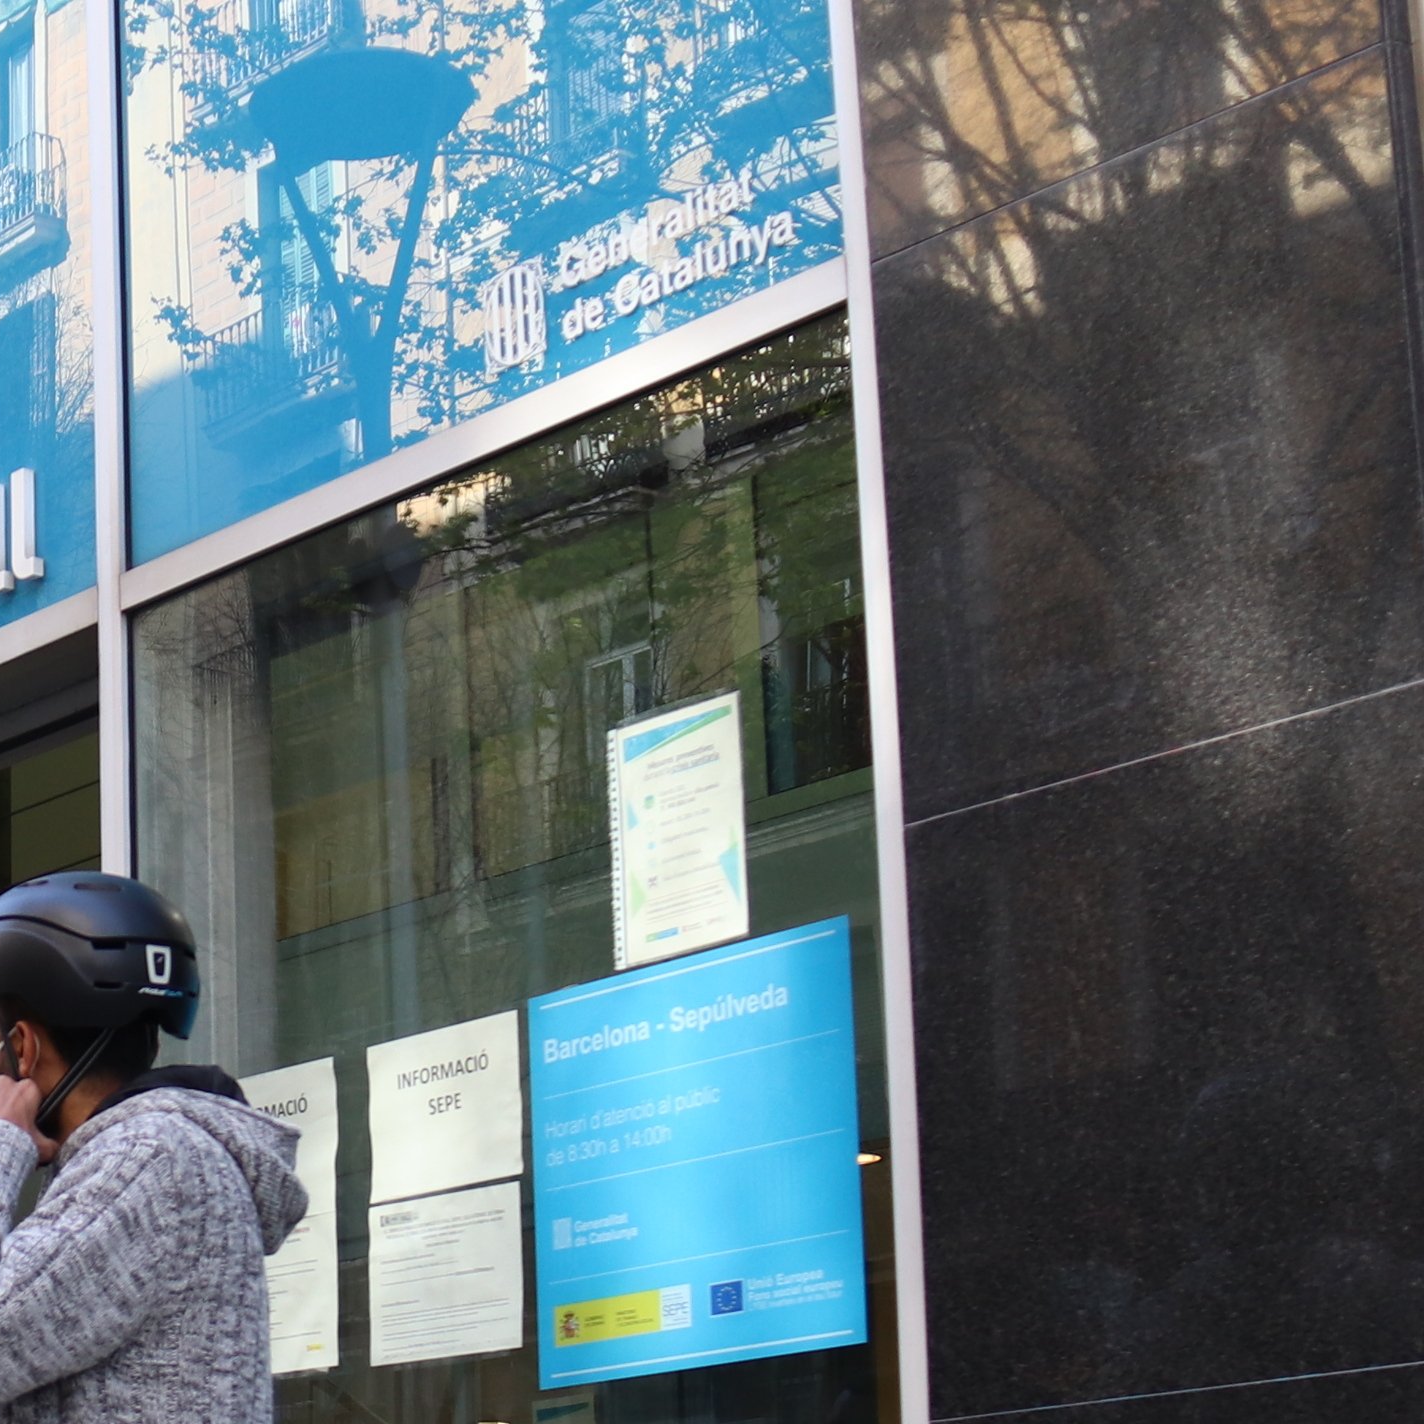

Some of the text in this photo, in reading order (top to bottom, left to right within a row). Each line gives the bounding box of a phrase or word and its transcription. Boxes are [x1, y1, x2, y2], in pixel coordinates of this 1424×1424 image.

[556, 173, 757, 289] Generalitat
[560, 210, 798, 342] de Catalunya
[543, 1020, 650, 1063] Barcelona
[669, 983, 789, 1032] Sepúlveda
[397, 1049, 489, 1090] INFORMACIÓ
[428, 1093, 462, 1115] SEPE
[544, 1114, 587, 1138] Horari
[657, 1095, 672, 1115] al
[674, 1085, 720, 1114] públic
[546, 1149, 565, 1166] de
[610, 1139, 621, 1154] a
